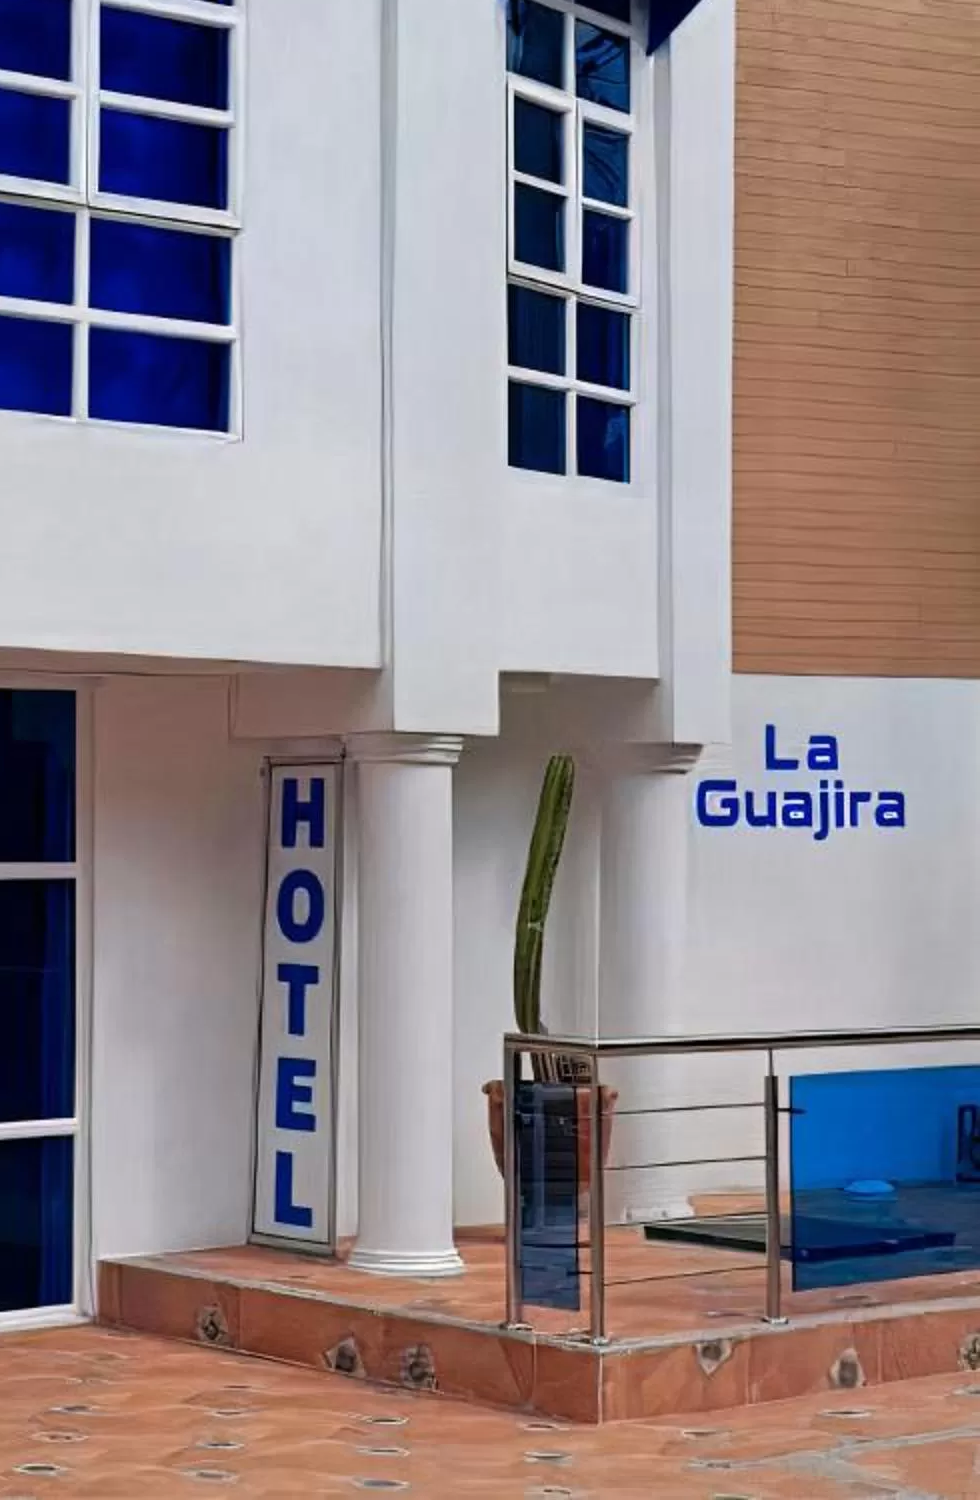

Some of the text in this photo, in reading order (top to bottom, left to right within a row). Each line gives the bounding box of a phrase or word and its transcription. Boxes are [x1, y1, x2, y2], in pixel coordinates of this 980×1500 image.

[765, 723, 839, 770] La
[697, 779, 905, 841] Guajira
[274, 778, 325, 1228] HOTEL
